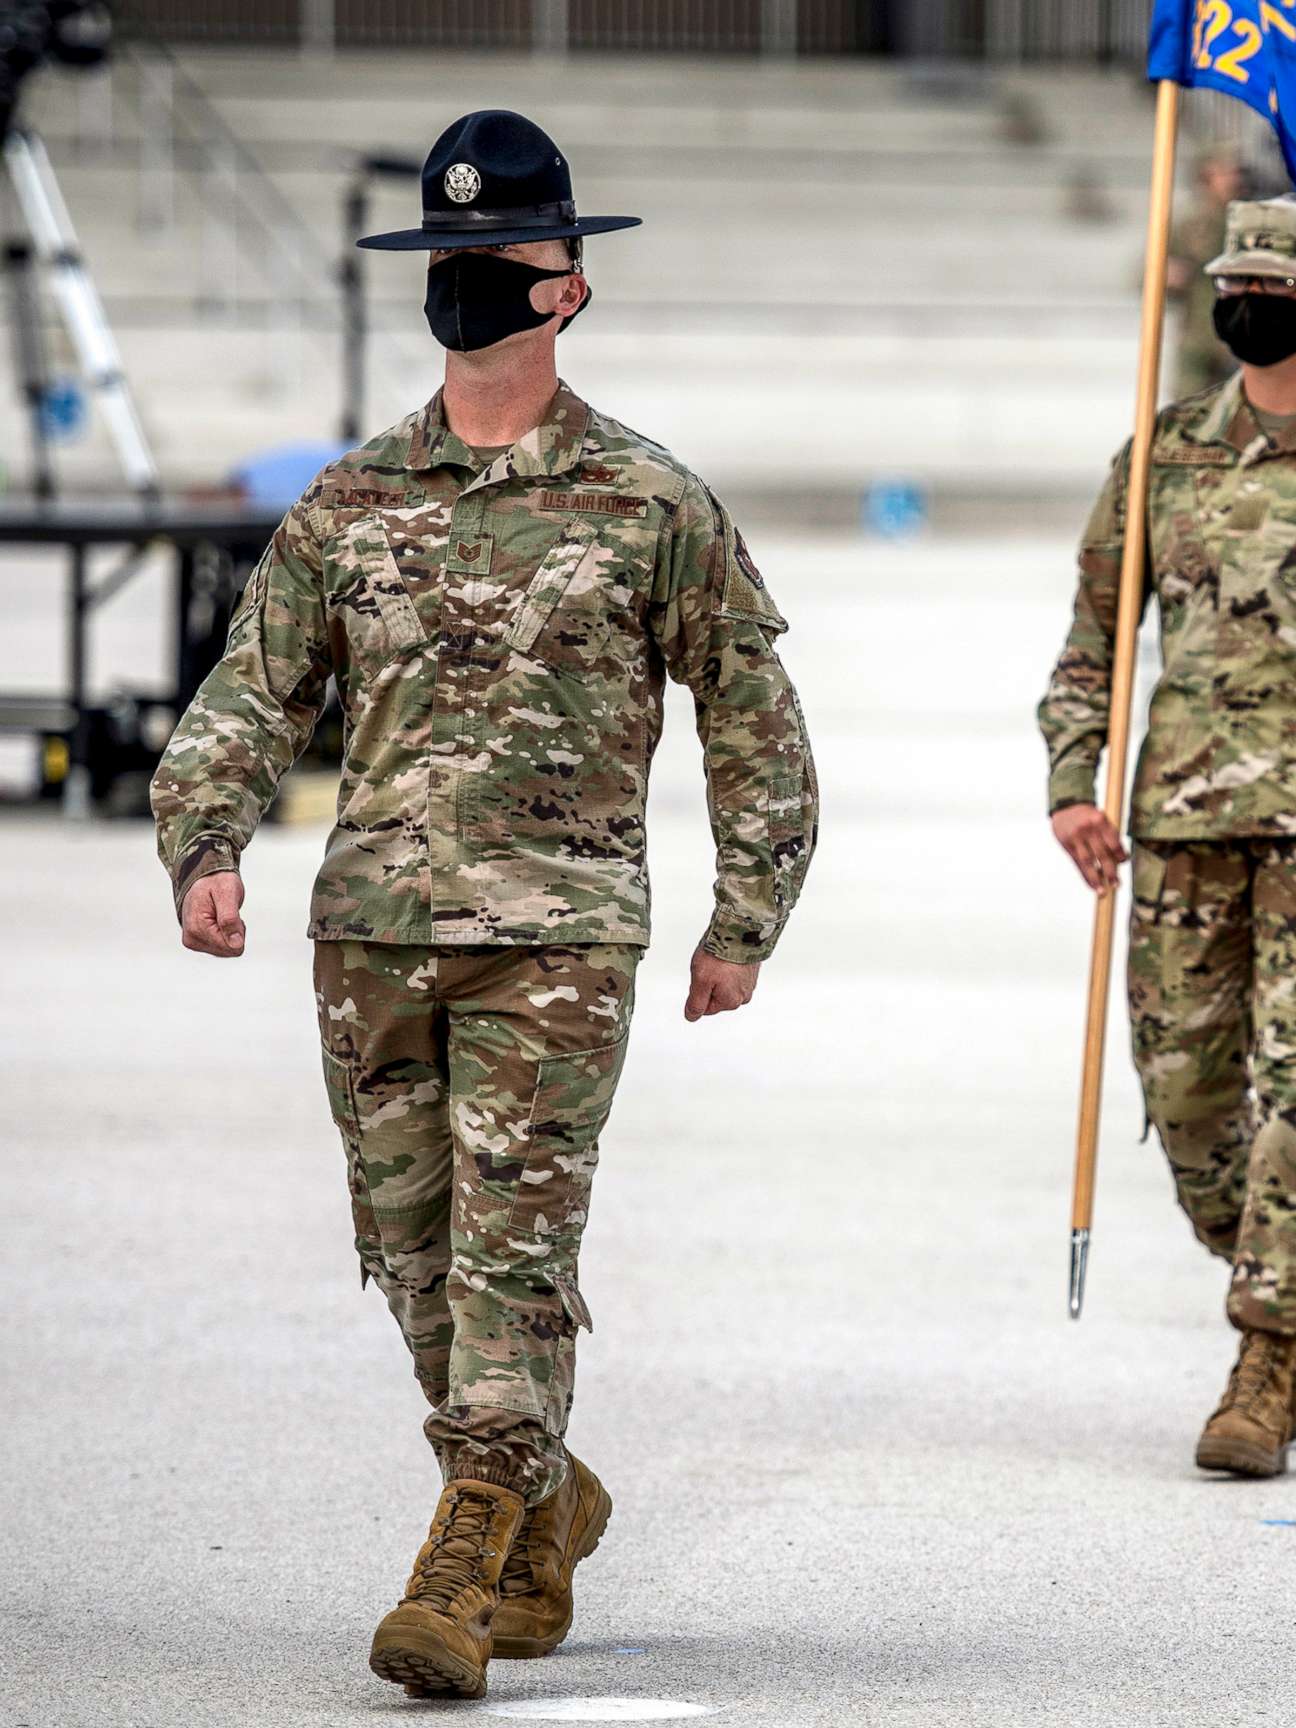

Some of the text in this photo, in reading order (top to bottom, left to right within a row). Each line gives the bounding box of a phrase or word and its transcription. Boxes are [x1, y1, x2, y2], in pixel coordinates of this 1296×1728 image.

[543, 491, 641, 516] U.S. AIR FORCE
